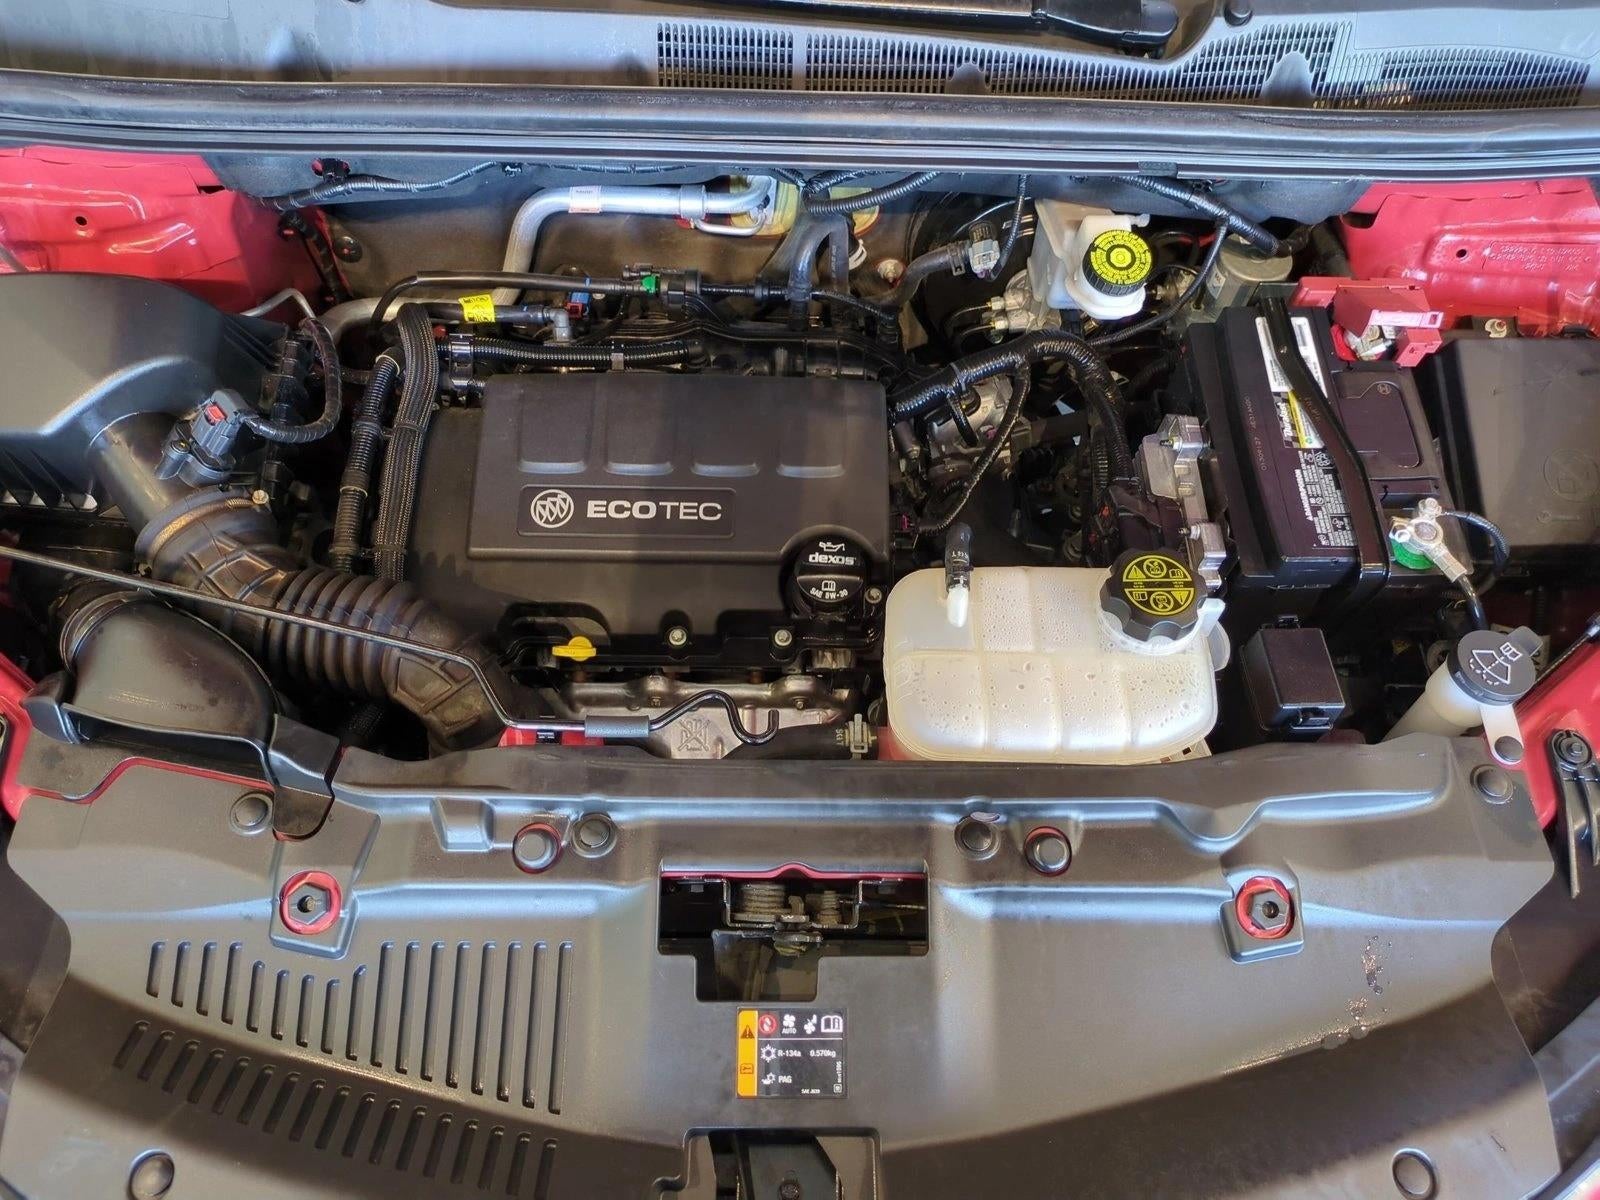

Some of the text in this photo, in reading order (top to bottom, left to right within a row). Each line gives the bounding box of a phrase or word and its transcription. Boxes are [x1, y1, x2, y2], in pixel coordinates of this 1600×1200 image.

[1276, 402, 1294, 437] Duralast
[586, 500, 722, 521] ECOTEC
[808, 552, 855, 565] dexos
[809, 587, 824, 599] SAE
[777, 1049, 802, 1058] R-134a
[778, 1075, 792, 1084] PAG
